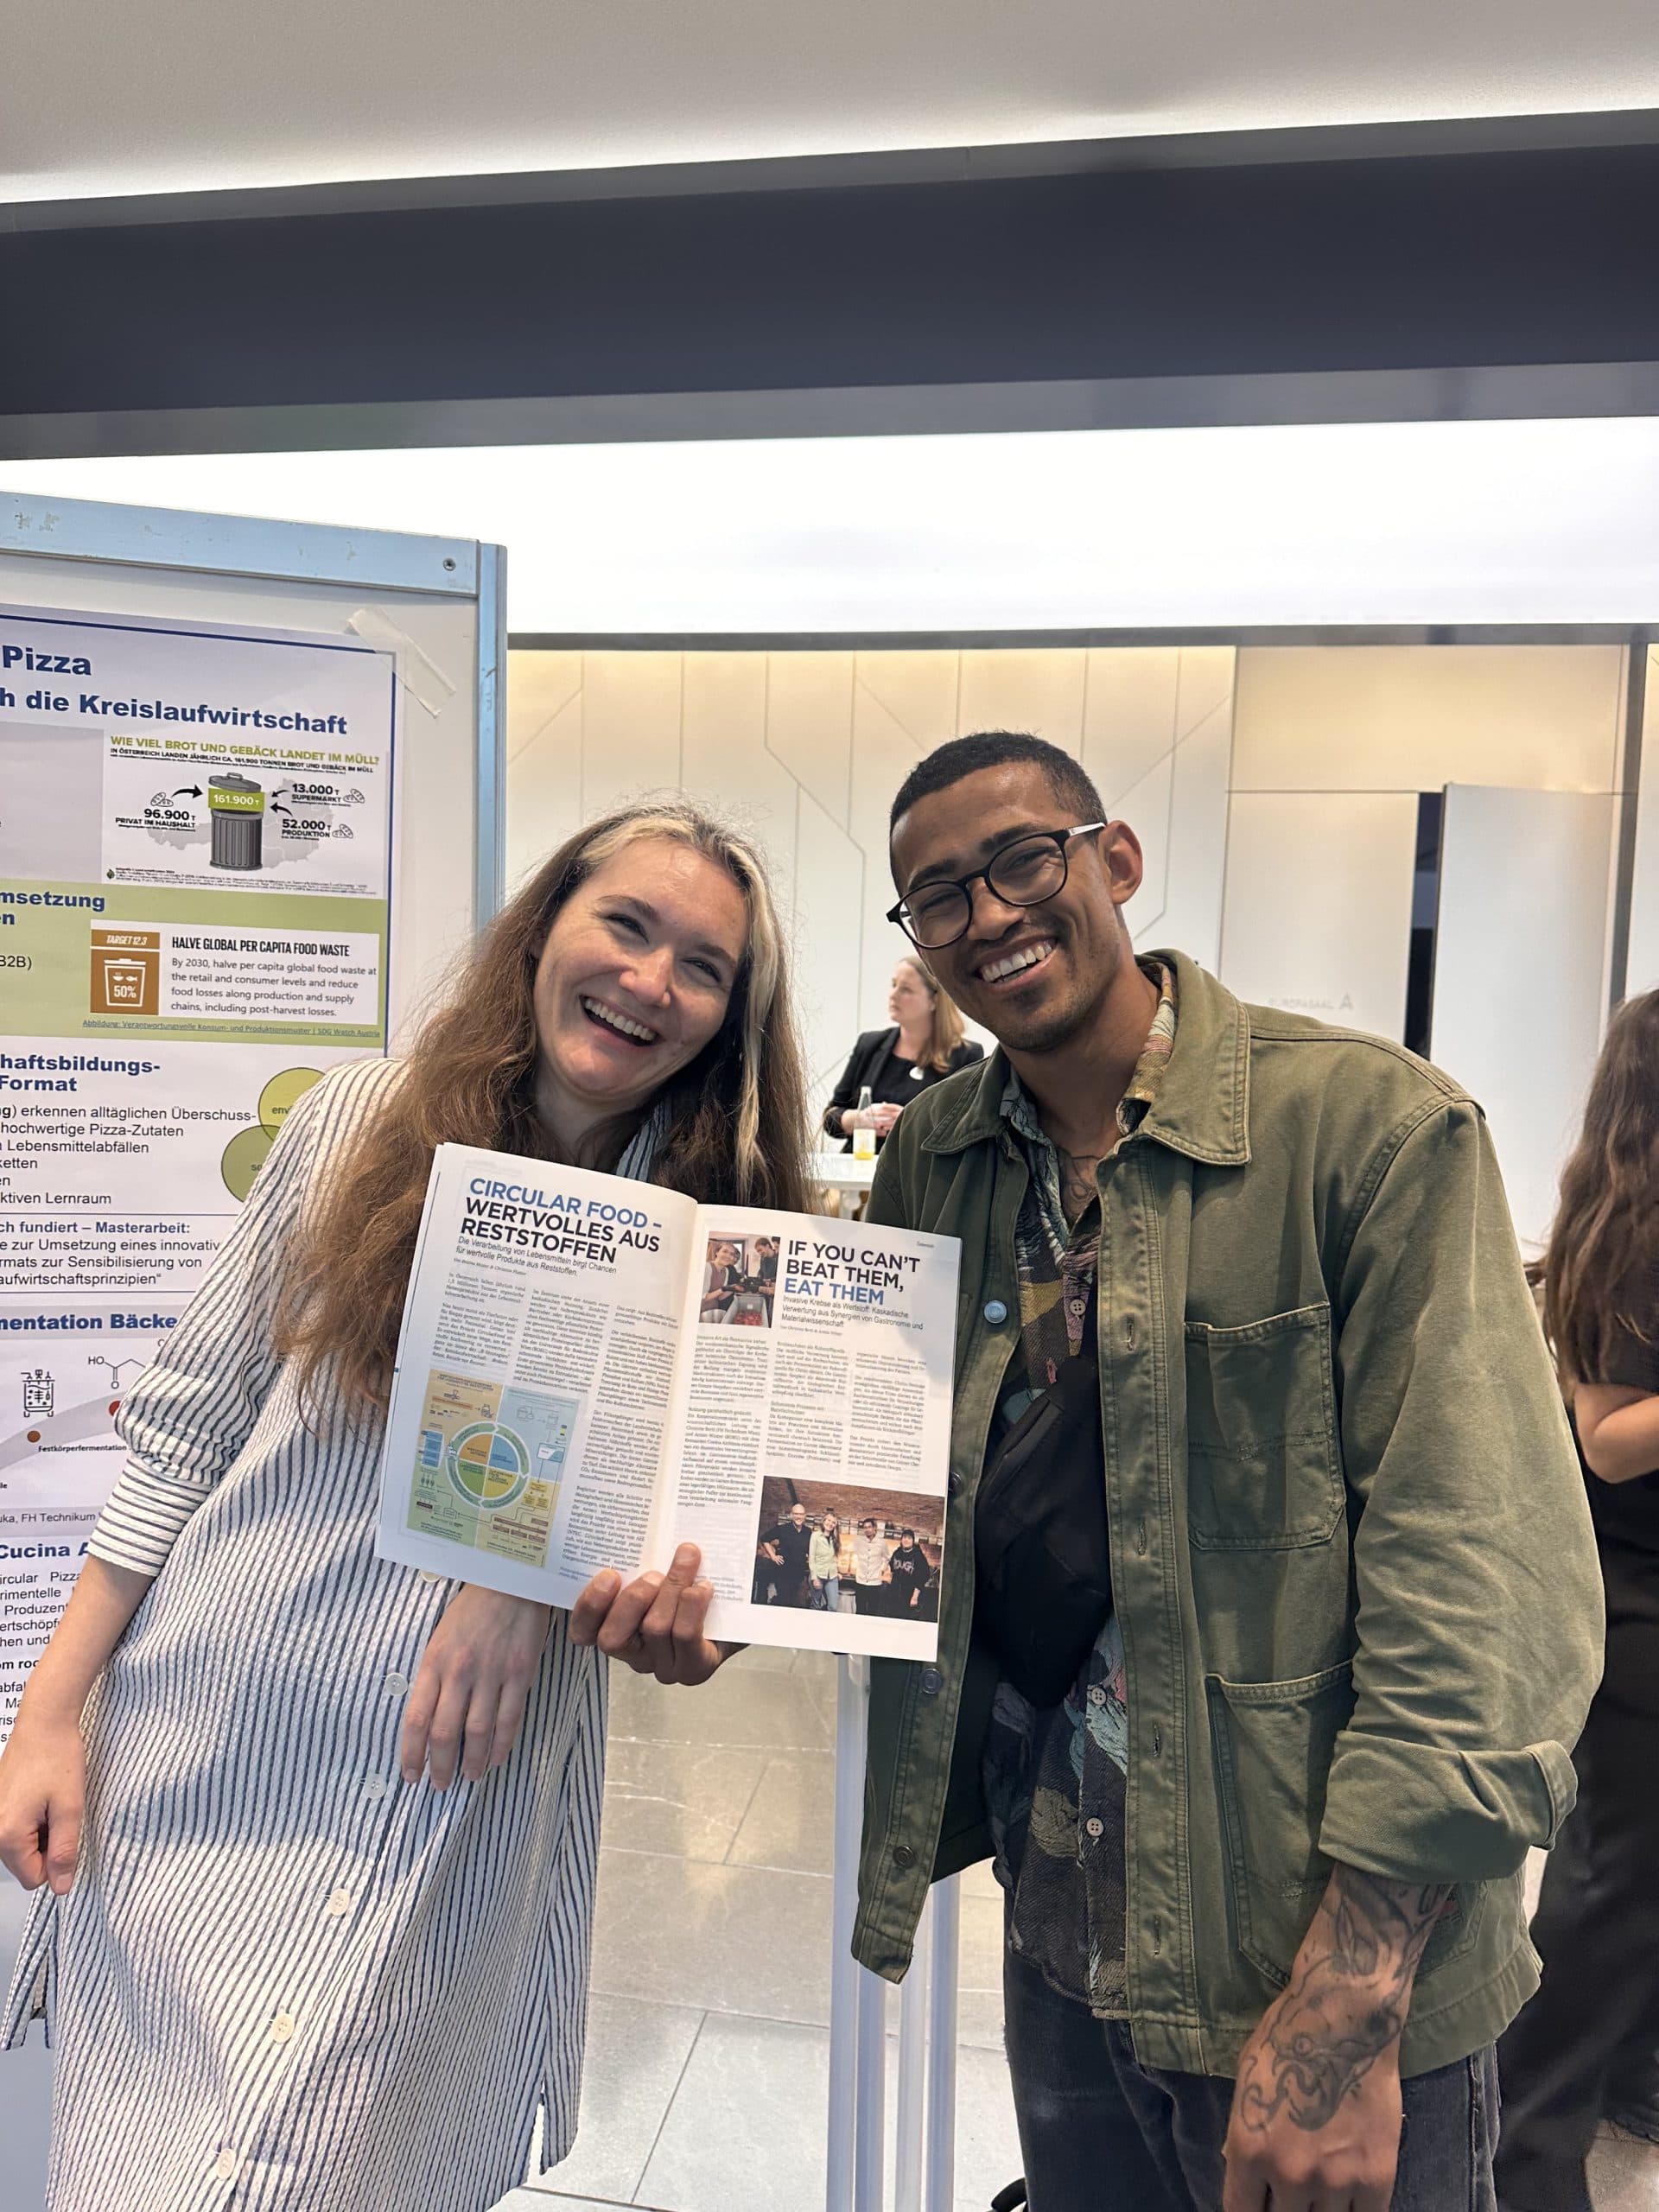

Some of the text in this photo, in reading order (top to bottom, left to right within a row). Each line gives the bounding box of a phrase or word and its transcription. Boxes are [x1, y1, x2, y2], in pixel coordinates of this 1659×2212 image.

[2, 645, 92, 676] Pizza
[26, 690, 70, 712] die
[79, 694, 347, 734] Kreislaufwirtschaft
[111, 735, 380, 766] WIE VIEL BROT UND GEBÄCK LANDET IM MÜLL?
[118, 747, 160, 757] ÖSTERREICH
[162, 751, 188, 760] LANDEN
[189, 753, 221, 761] JÄHRLICH
[259, 759, 287, 767] TONNEN
[321, 763, 346, 772] GEBÄCK
[292, 784, 334, 795] 13.000
[213, 794, 255, 806] 161.900
[291, 793, 342, 804] SUPERMARKT
[143, 808, 190, 821] 96.900
[115, 817, 143, 825] PRIVAT
[144, 817, 154, 826] IM
[155, 818, 196, 829] HAUSHALT
[282, 818, 326, 830] 52.000
[281, 829, 331, 838] PRODUKTION
[106, 934, 148, 946] TARGET 12.3
[172, 936, 350, 957] HALVE GLOBAL PER CAPITA FOOD WASTE
[172, 957, 377, 976] By 2030, halve per capita global food waste at
[171, 972, 359, 989] the retail and consumer levels and reduce
[113, 984, 137, 999] 50%
[171, 987, 354, 1005] food losses along production and supply
[170, 1001, 337, 1017] chains, including post-harvest losses.
[0, 1074, 78, 1092] Format
[21, 1104, 257, 1122] erkennen alltäglichen Überschuss-
[1, 1122, 184, 1137] hochwertige Pizza-Zutaten
[7, 1139, 149, 1154] Lebensmittelabfällen
[46, 1192, 111, 1205] Lernraum
[469, 1177, 649, 1229] CIRCULAR FOOD
[19, 1221, 79, 1234] fundiert
[95, 1221, 191, 1235] Masterarbeit:
[465, 1196, 661, 1253] WERTVOLLES AUS
[11, 1240, 34, 1251] zur
[38, 1237, 117, 1253] Umsetzung
[120, 1238, 157, 1251] eines
[460, 1217, 617, 1264] RESTSTOFFEN
[41, 1258, 64, 1268] zur
[67, 1255, 175, 1270] Sensibilisierung
[177, 1257, 202, 1268] von
[455, 1245, 465, 1255] für
[466, 1248, 495, 1260] wertvolle
[496, 1253, 526, 1267] Produkte
[526, 1260, 539, 1269] aus
[539, 1262, 579, 1277] Reststoffen.
[458, 1236, 470, 1245] Die
[471, 1237, 512, 1255] Verarbeitung
[513, 1248, 525, 1256] von
[572, 1259, 588, 1270] birgt
[588, 1262, 618, 1274] Chancen
[787, 1239, 921, 1274] IF YOU CAN’T
[786, 1258, 905, 1294] BEAT THEM,
[784, 1277, 886, 1306] EAT THEM
[783, 1295, 910, 1319] Invasive Krebse als Kaskadische
[781, 1313, 845, 1329] Materialwissenschaft
[782, 1304, 925, 1332] Verwertung aus Synergien von Gastronomie und
[38, 1444, 128, 1454] Festkörperfermentation
[21, 1511, 96, 1523] FH Technikum
[27, 1634, 50, 1646] und
